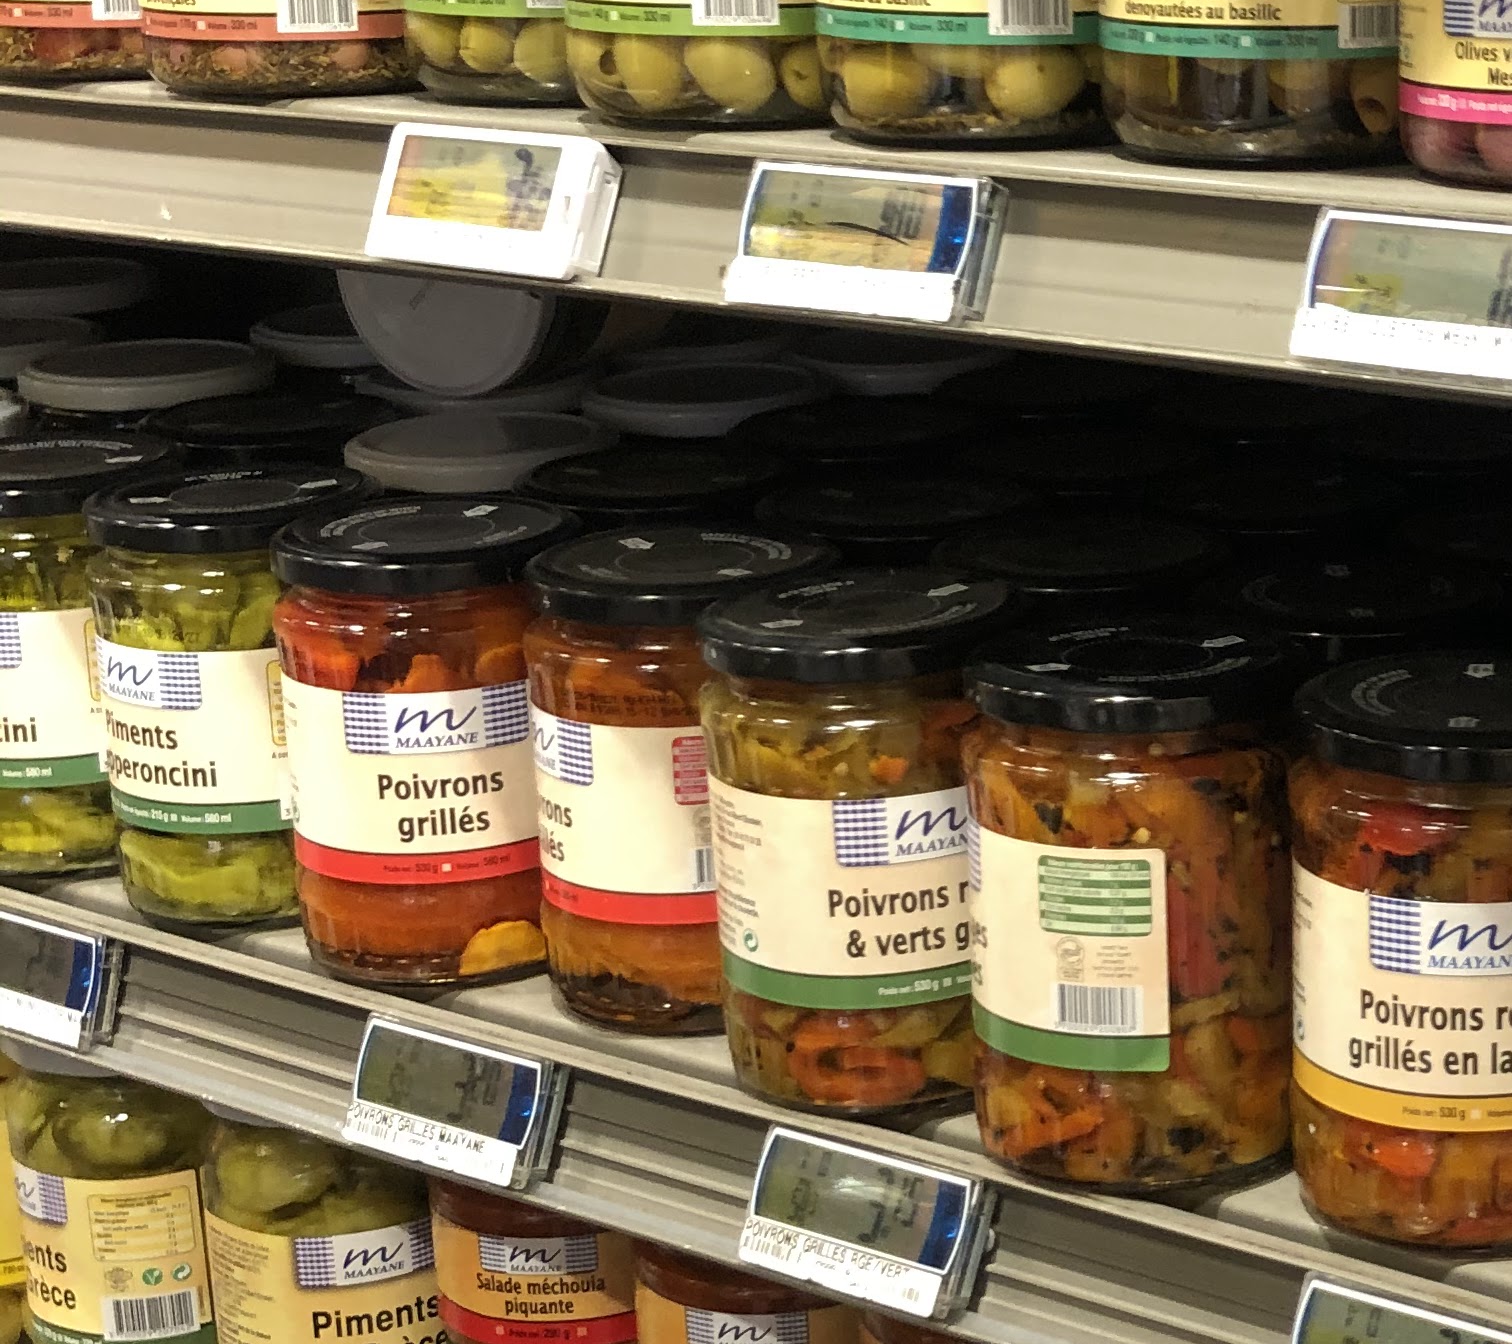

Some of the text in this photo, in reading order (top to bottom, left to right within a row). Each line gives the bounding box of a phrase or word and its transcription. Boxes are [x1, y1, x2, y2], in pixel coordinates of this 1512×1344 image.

[1206, 5, 1224, 20] au
[1227, 3, 1281, 22] basilic
[1455, 41, 1498, 62] Olives
[108, 682, 155, 702] MAAYANE
[395, 733, 478, 749] MAAYANE
[377, 767, 504, 801] Poivrons
[398, 806, 490, 843] grillés
[828, 885, 949, 918] Poivrons
[846, 928, 946, 958] & verts
[1360, 986, 1484, 1032] Poivrons
[1348, 1032, 1432, 1076] grillés
[1443, 1050, 1479, 1076] en
[344, 1260, 406, 1279] MAAYANE
[477, 1273, 606, 1294] Salade méchouia
[504, 1298, 574, 1316] piquante
